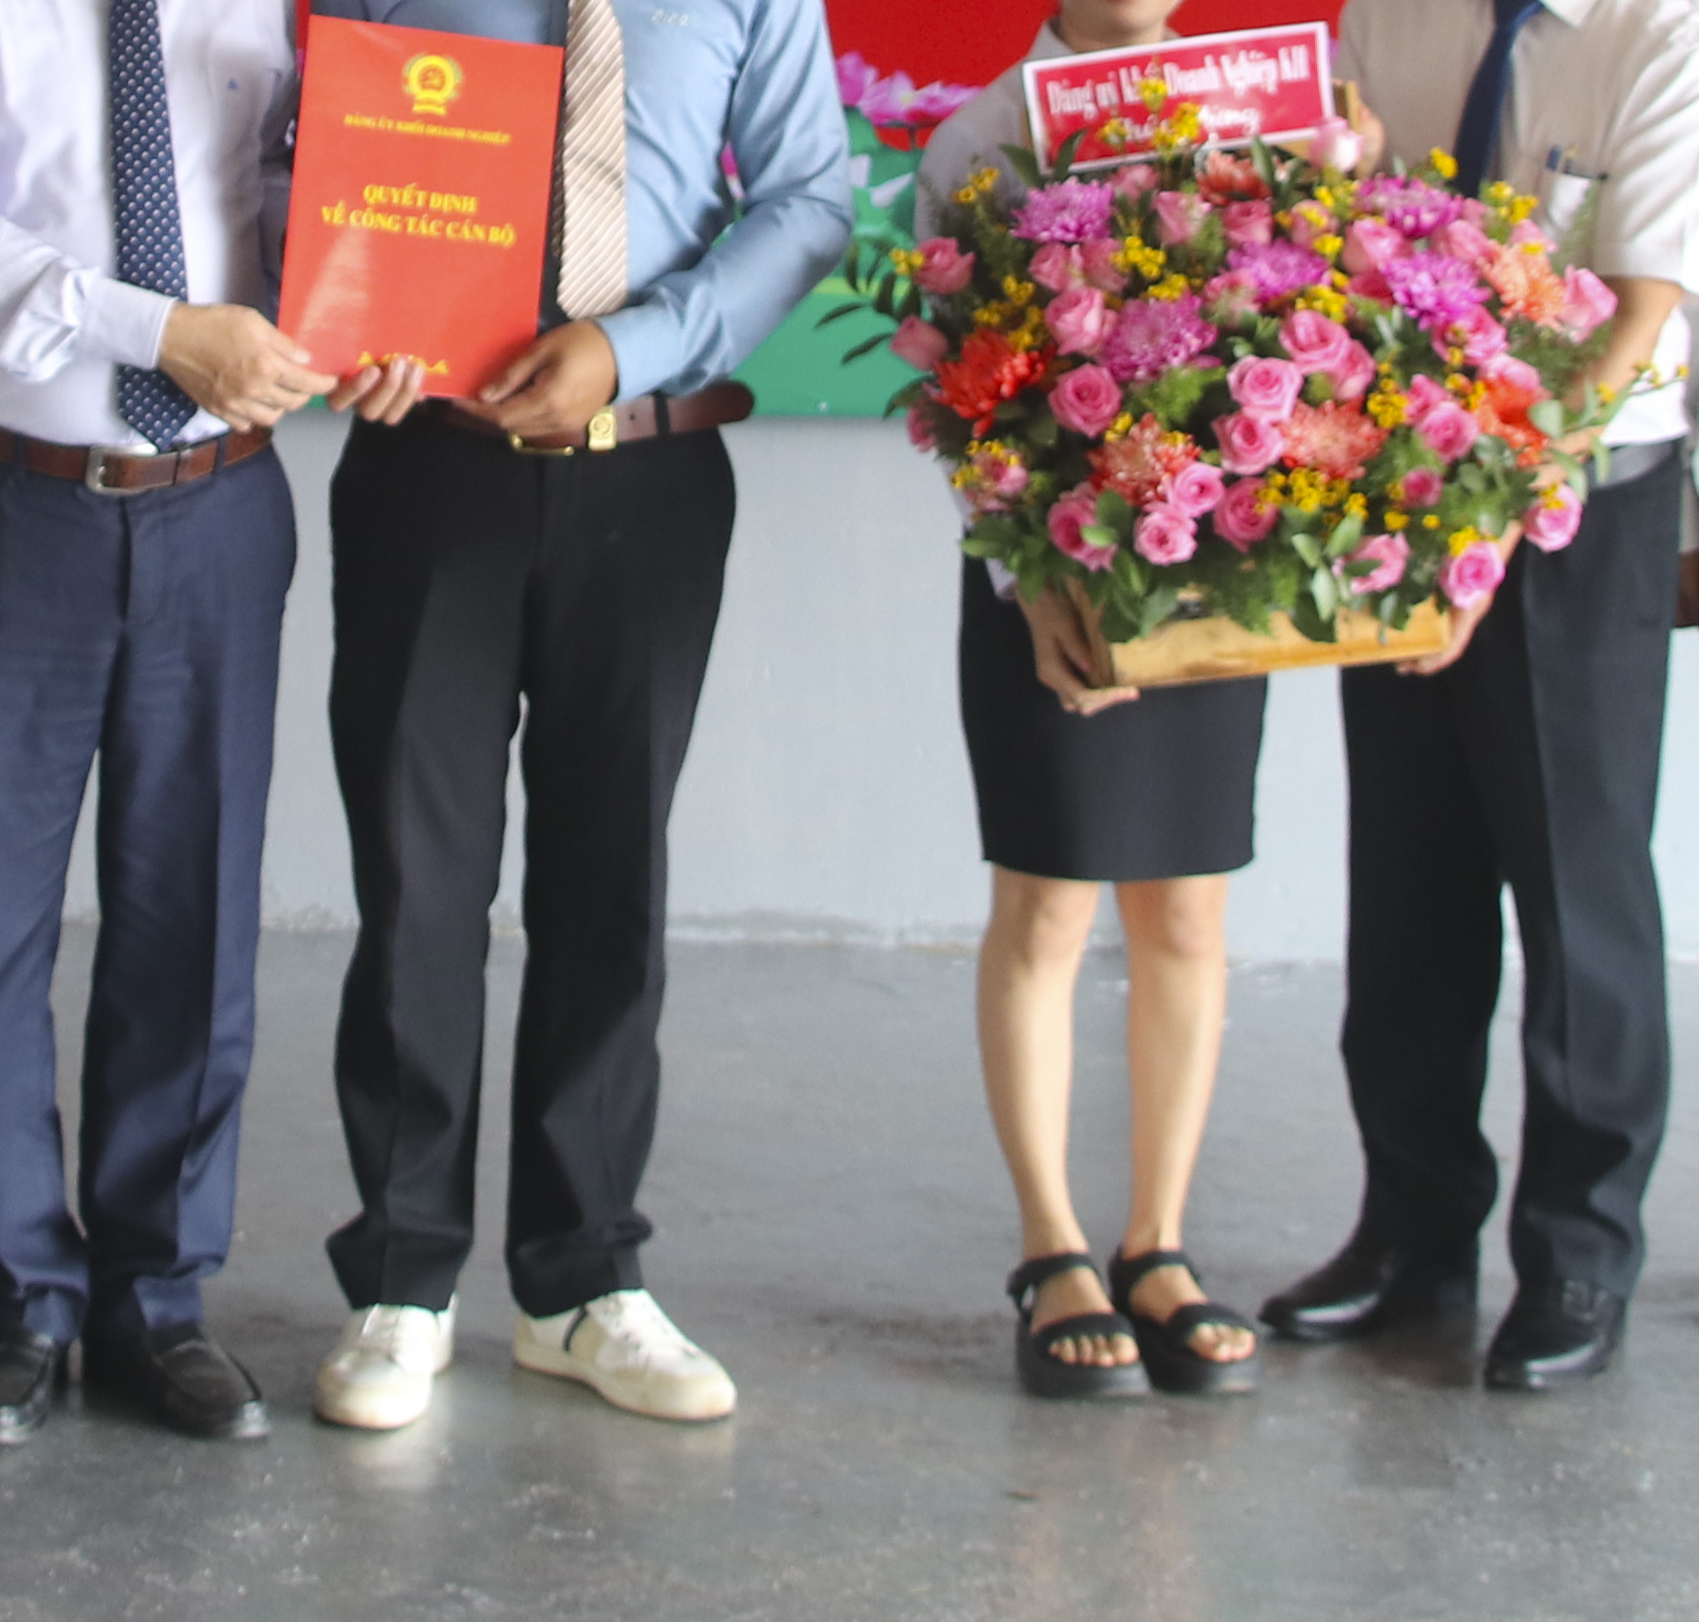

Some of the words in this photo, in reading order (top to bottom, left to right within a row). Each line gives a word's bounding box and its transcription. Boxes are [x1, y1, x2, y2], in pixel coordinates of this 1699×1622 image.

[363, 183, 425, 207] QUYẾT
[429, 191, 476, 213] ĐỊNH
[349, 207, 400, 232] CÔNG
[404, 213, 442, 236] TÁC
[445, 218, 484, 240] CÁN
[487, 223, 515, 246] BỘ
